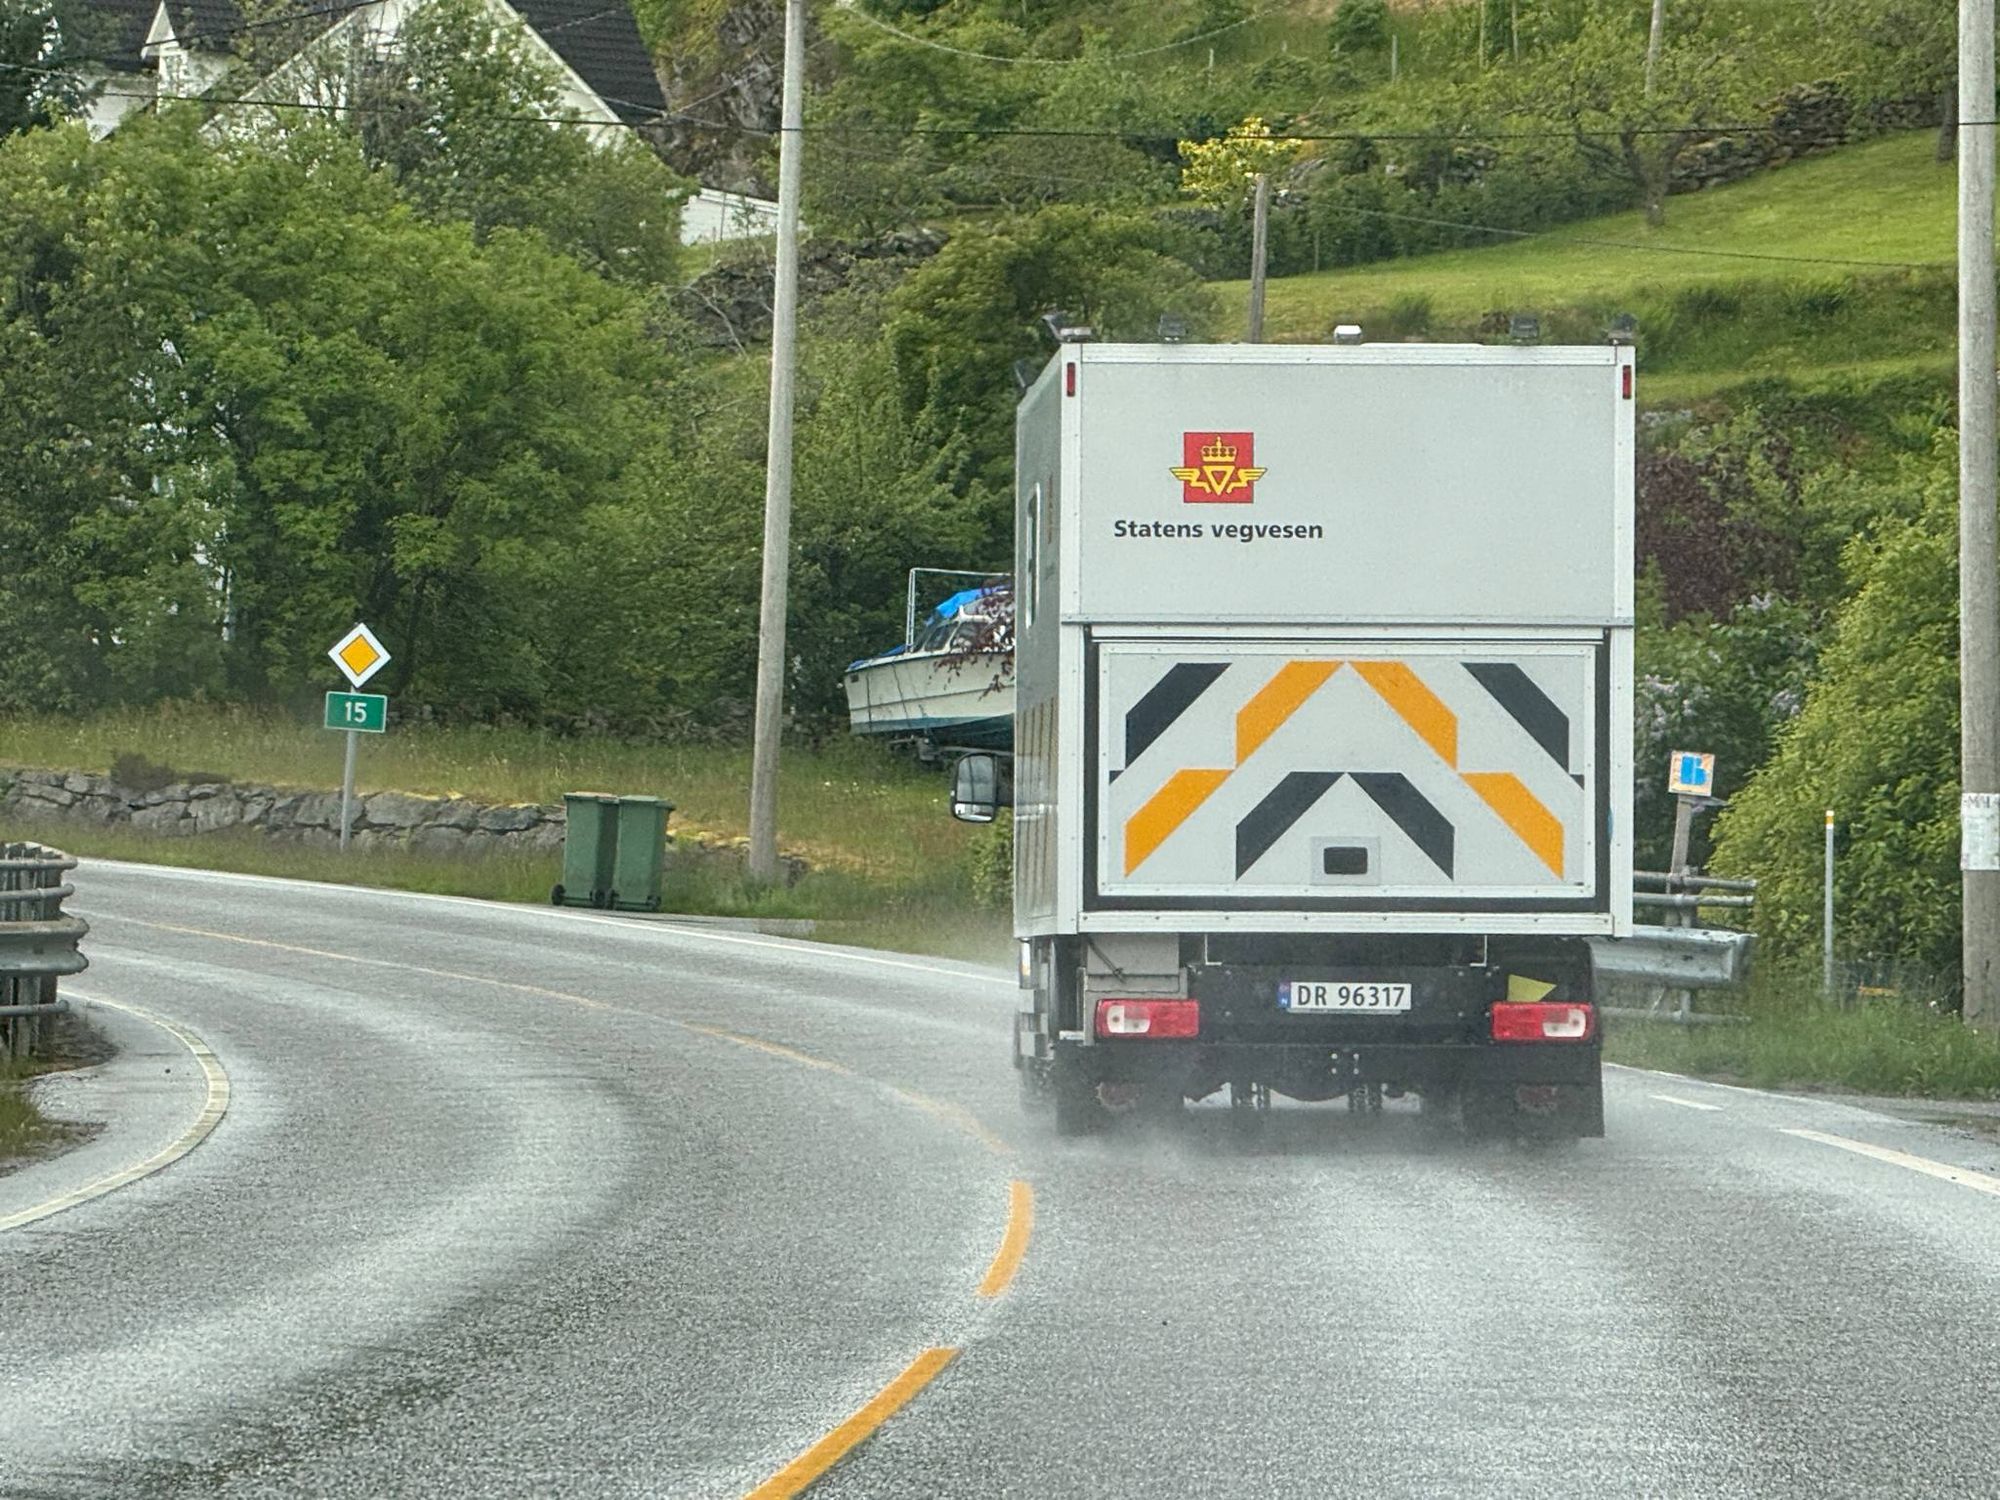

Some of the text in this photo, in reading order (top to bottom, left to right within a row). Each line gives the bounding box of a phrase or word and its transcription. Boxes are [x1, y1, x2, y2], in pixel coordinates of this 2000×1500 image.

[1114, 519, 1323, 543] Statens vegvesen
[345, 701, 367, 723] 15
[1298, 985, 1405, 1007] DR 96317
